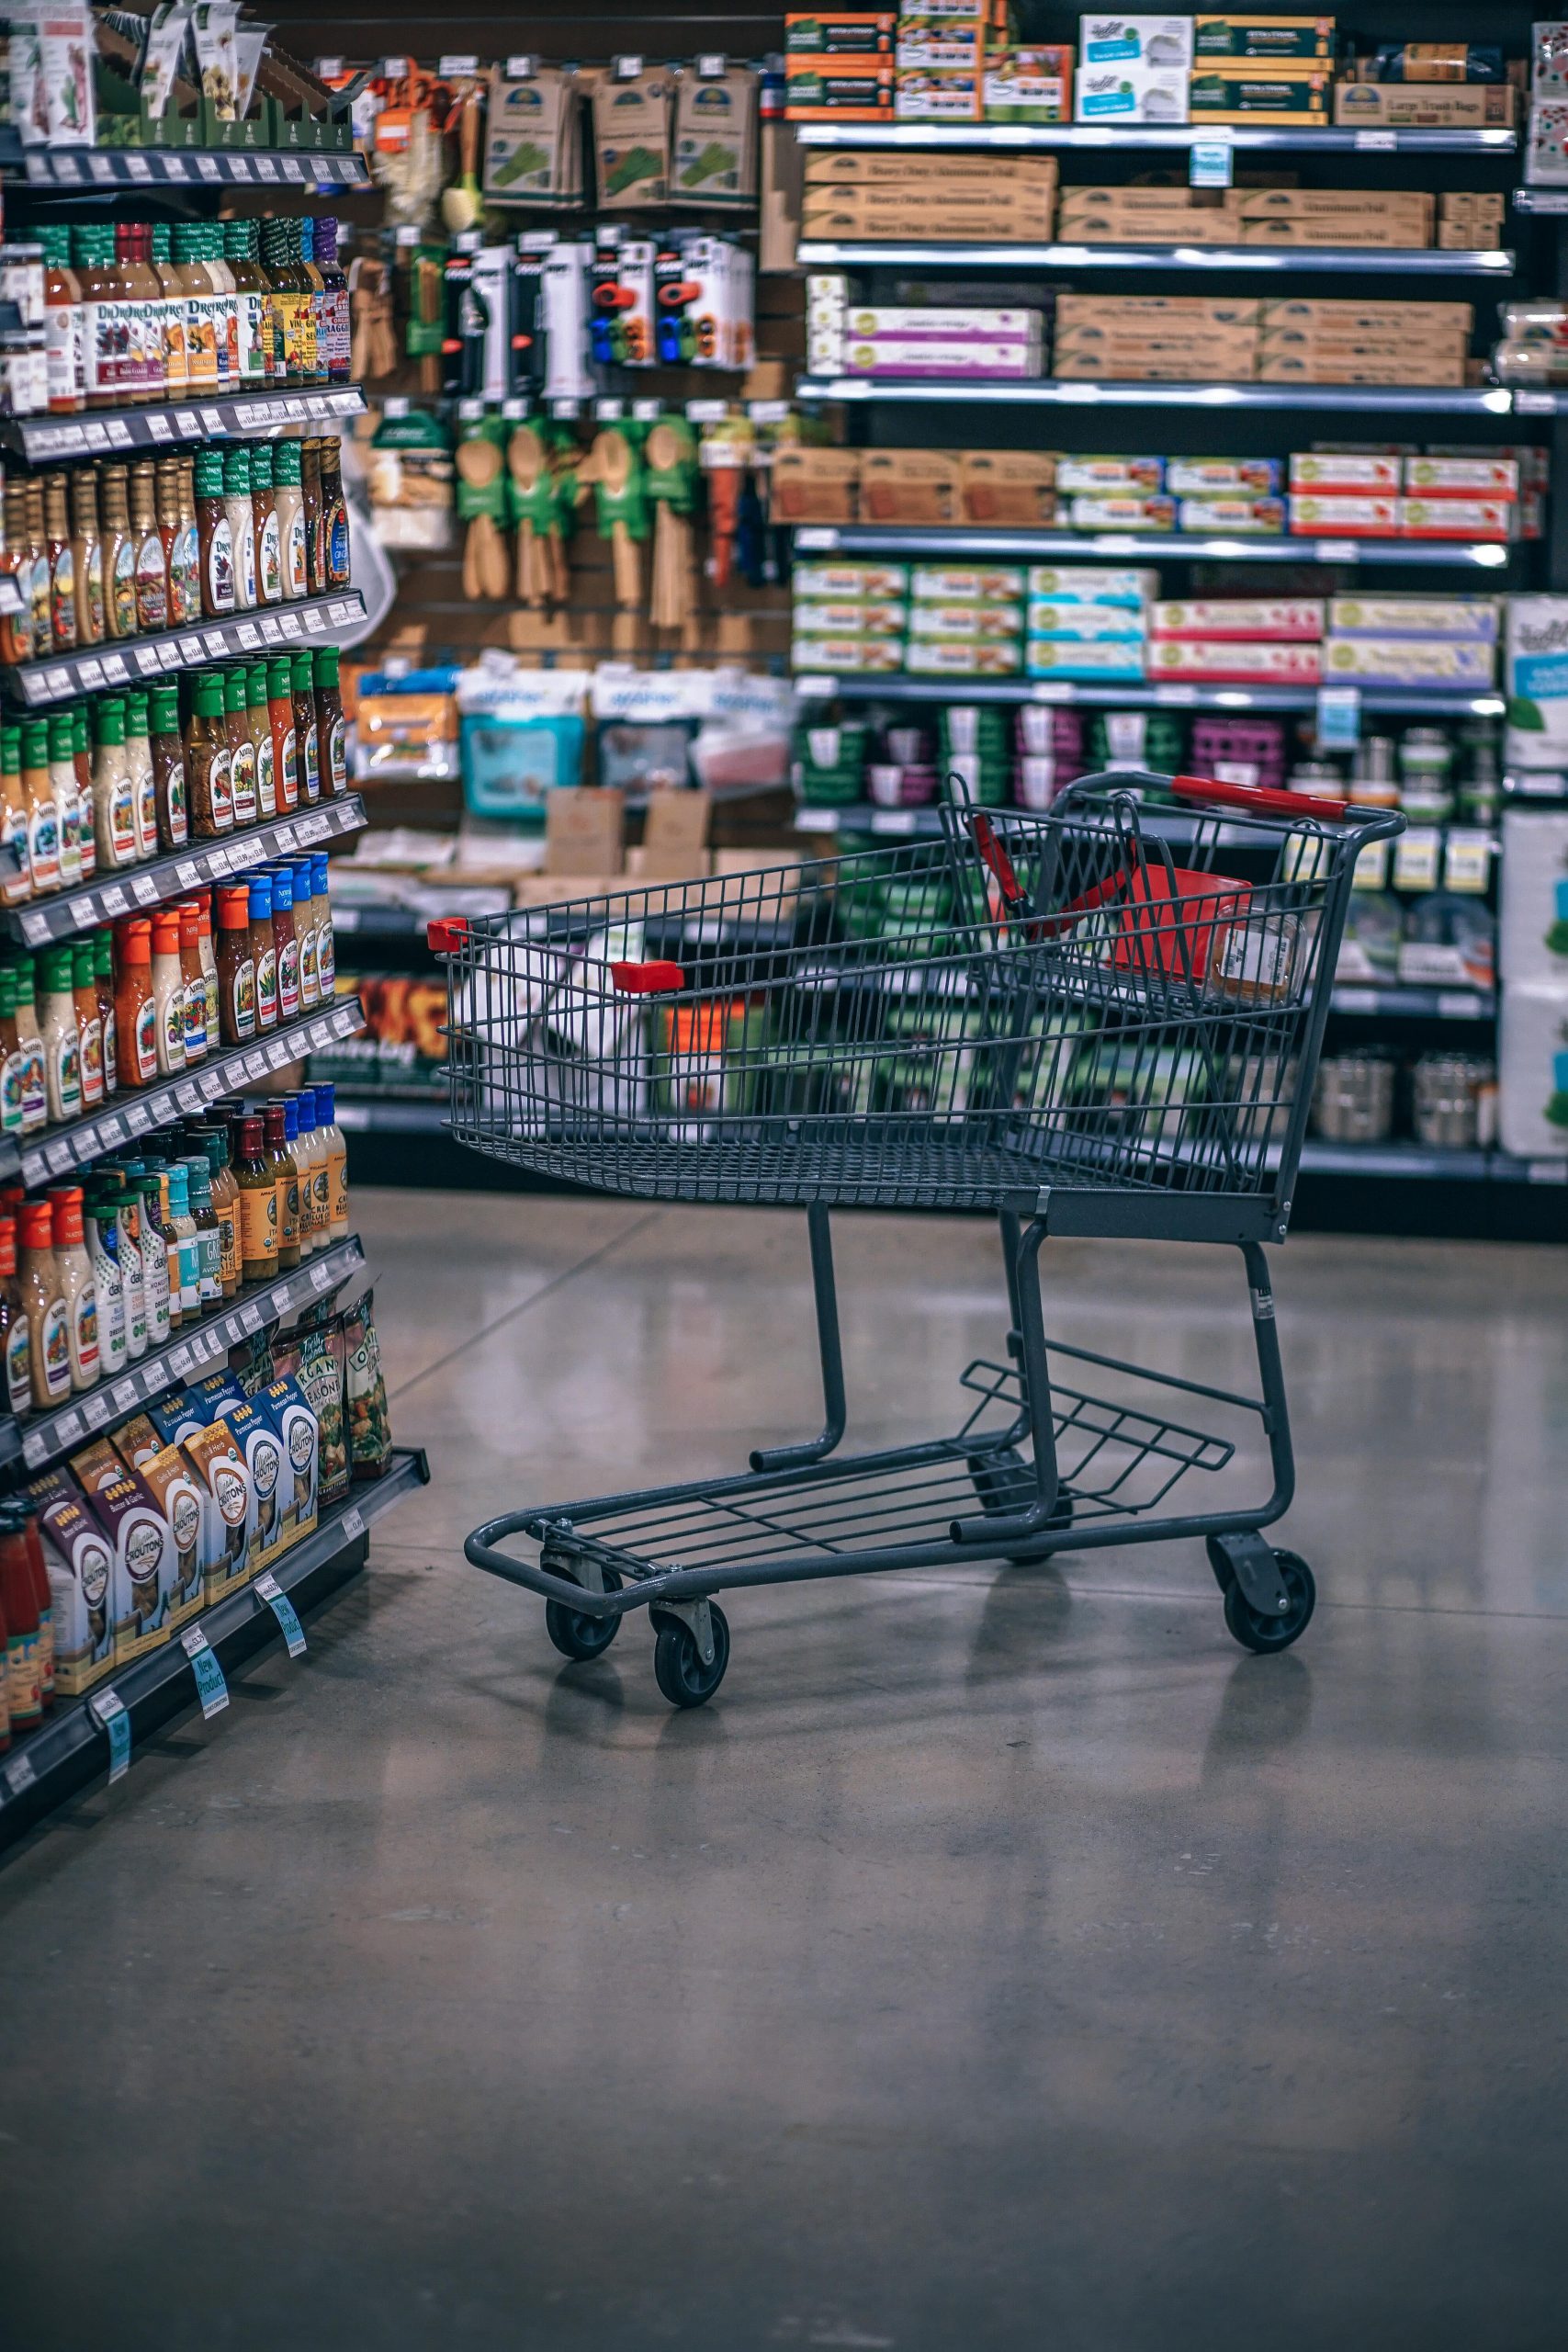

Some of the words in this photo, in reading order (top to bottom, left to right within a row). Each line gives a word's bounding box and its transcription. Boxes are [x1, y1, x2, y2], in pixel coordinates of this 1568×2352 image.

[213, 1441, 225, 1453] Herb
[288, 1432, 314, 1455] CROUTONS
[254, 1458, 279, 1482] CROUTONS
[125, 1535, 164, 1564] CROUTONS
[276, 1603, 289, 1617] New
[197, 1658, 213, 1676] New
[198, 1671, 224, 1697] Product
